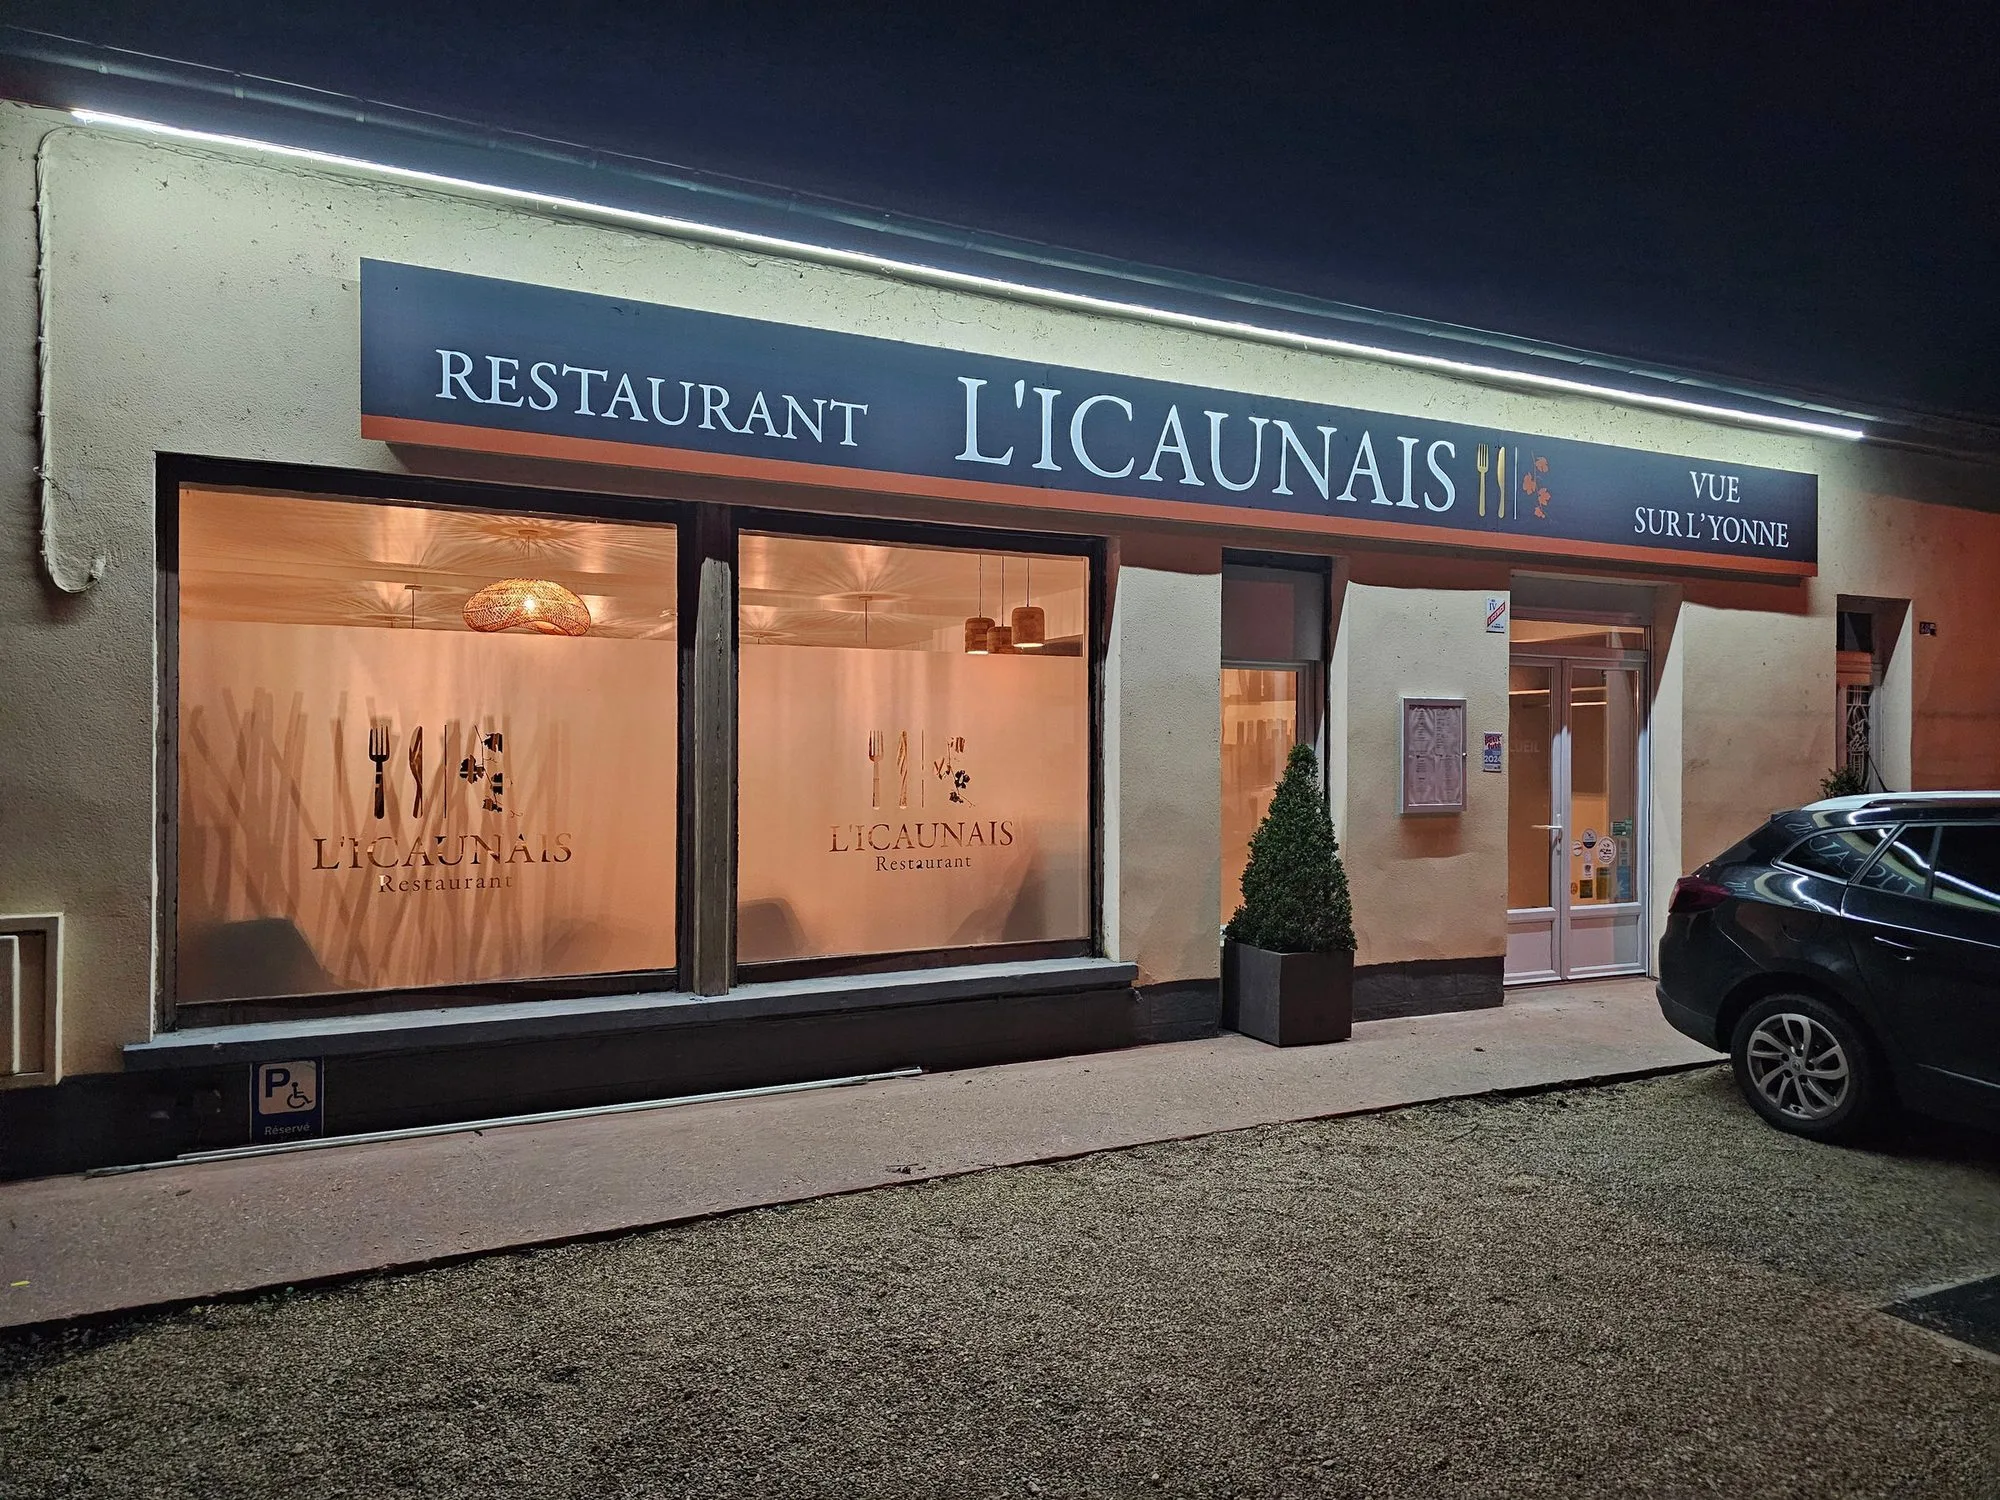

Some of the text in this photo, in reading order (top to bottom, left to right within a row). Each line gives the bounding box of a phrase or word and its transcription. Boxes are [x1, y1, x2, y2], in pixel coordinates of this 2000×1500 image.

[435, 349, 869, 448] RESTAURANT
[954, 376, 1457, 513] L'ICAUNAIS
[1689, 470, 1741, 504] VUE
[1634, 506, 1683, 537] SUR
[312, 833, 572, 870] L'ICAUNAIS
[829, 820, 1014, 853] L'ICAUNAIS
[877, 855, 973, 872] Restaurant
[378, 874, 514, 893] Restaurant
[265, 1068, 291, 1098] P
[264, 1122, 310, 1136] Réservé
